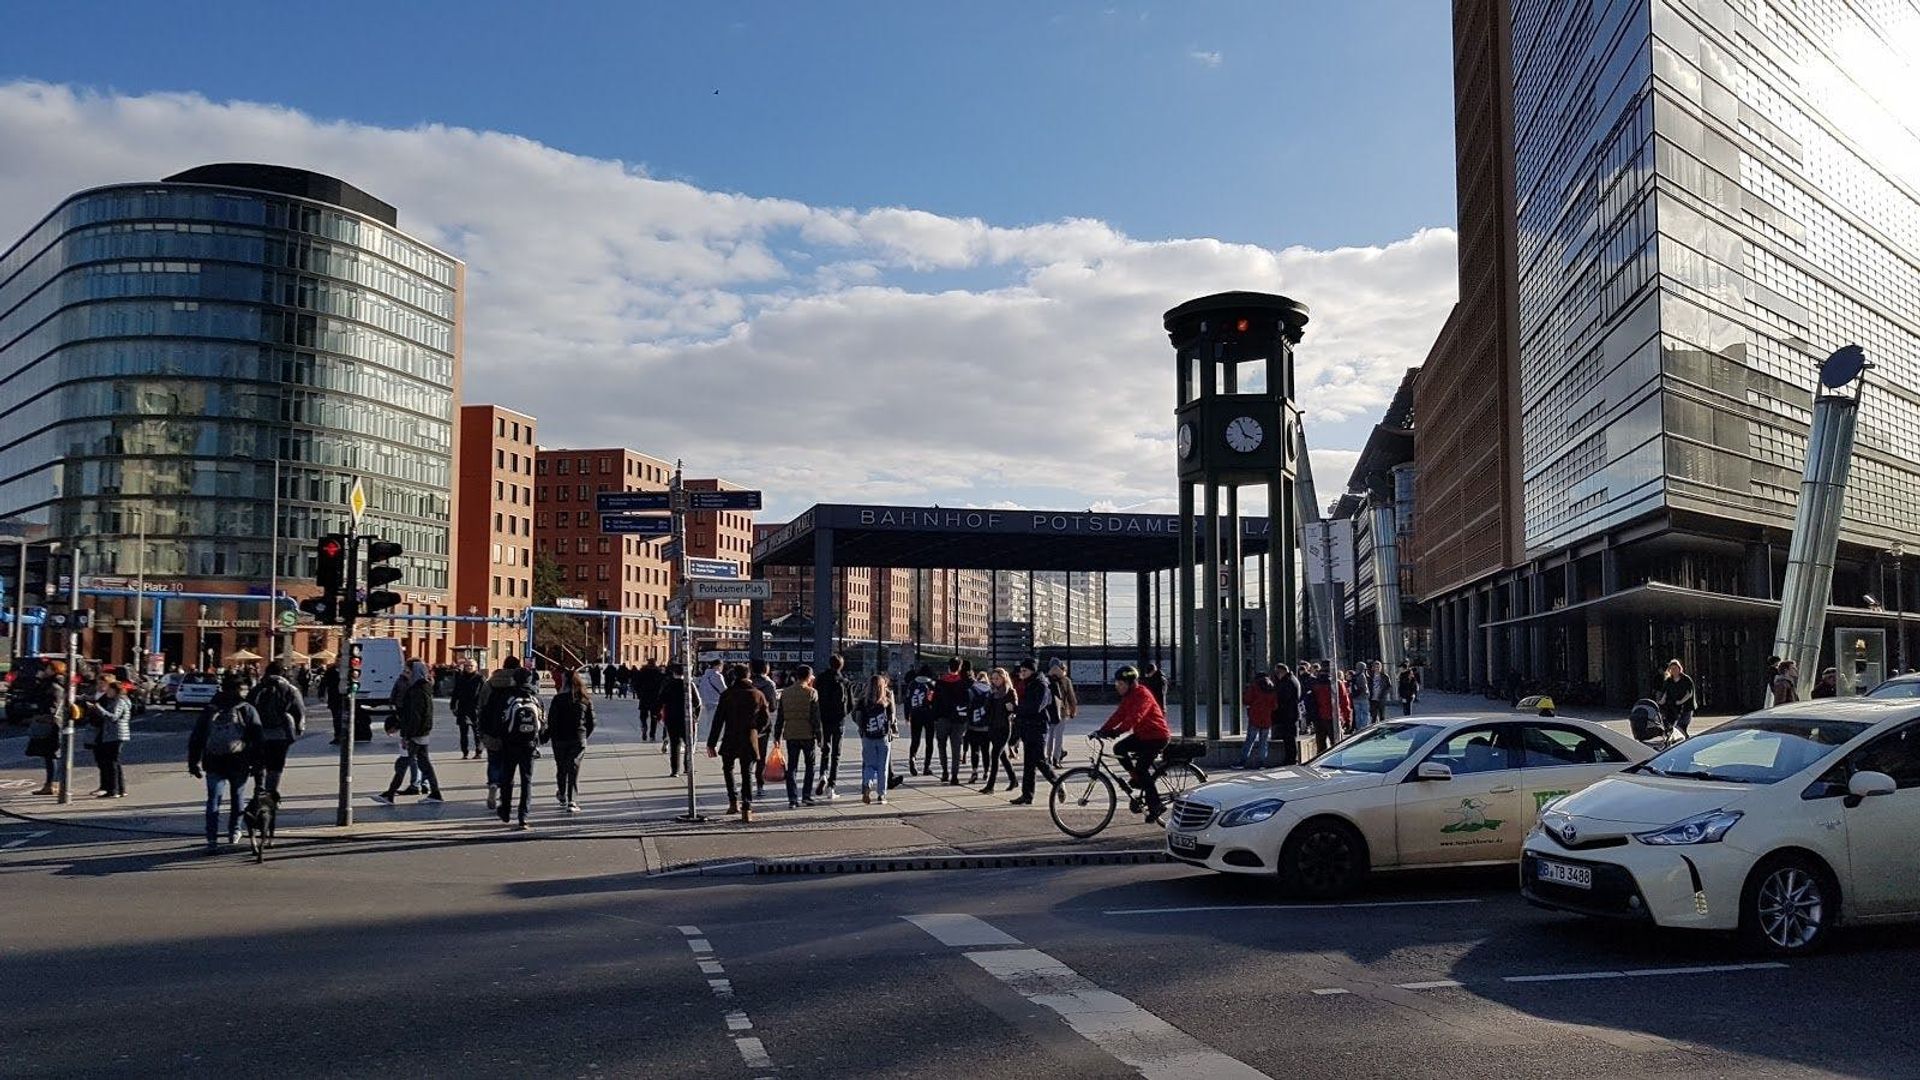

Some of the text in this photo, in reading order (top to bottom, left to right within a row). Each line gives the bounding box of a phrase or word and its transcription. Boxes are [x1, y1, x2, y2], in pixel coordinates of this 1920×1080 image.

[861, 509, 1001, 529] BAHNHOF
[144, 582, 168, 592] Platz
[699, 584, 764, 595] Potsdamer Platz
[232, 619, 261, 628] COFFEE
[283, 611, 296, 626] S
[1567, 867, 1590, 884] 3488
